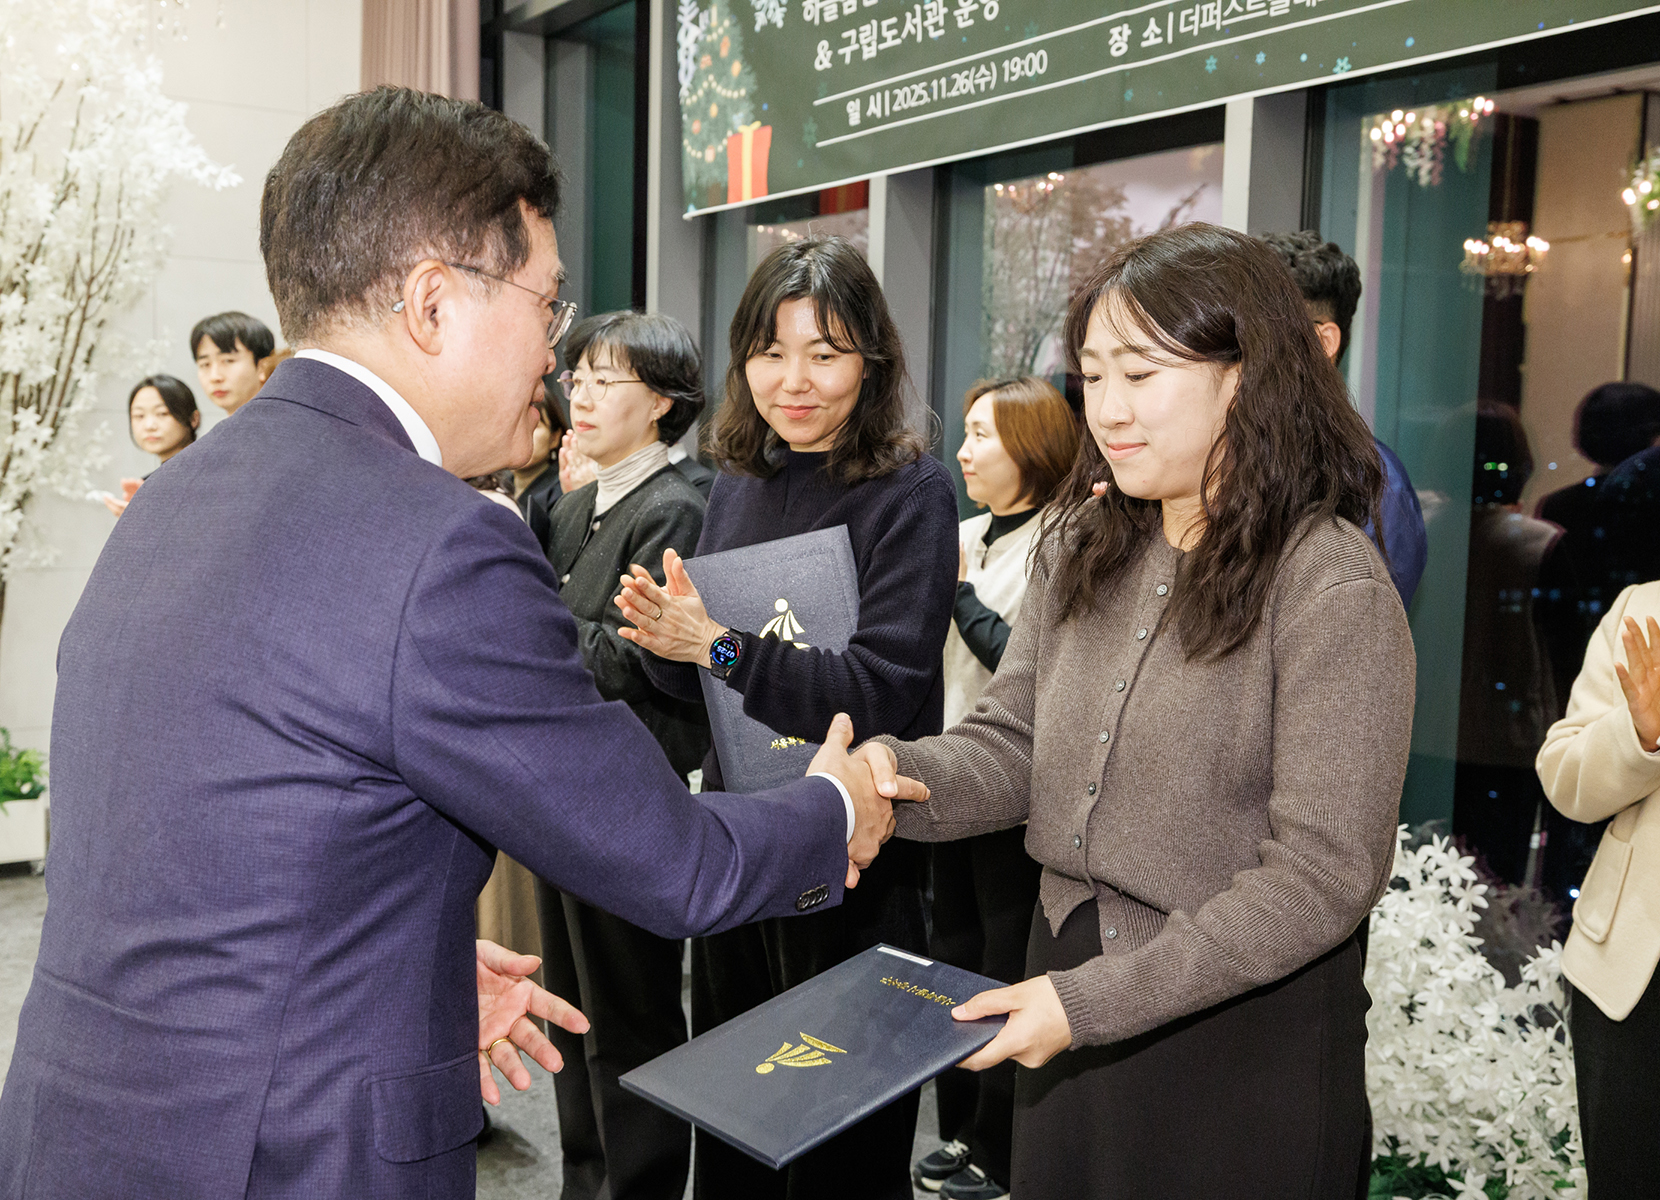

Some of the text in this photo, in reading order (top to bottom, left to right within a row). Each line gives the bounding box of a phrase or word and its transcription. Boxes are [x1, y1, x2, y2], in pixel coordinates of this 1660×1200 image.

[814, 40, 832, 71] &
[838, 0, 948, 64] 구립도서관
[1108, 0, 1324, 57] 장 소 더퍼스트
[892, 61, 997, 112] 2025.11.26(수)
[1001, 49, 1048, 83] 19:00
[716, 645, 736, 659] 07:25
